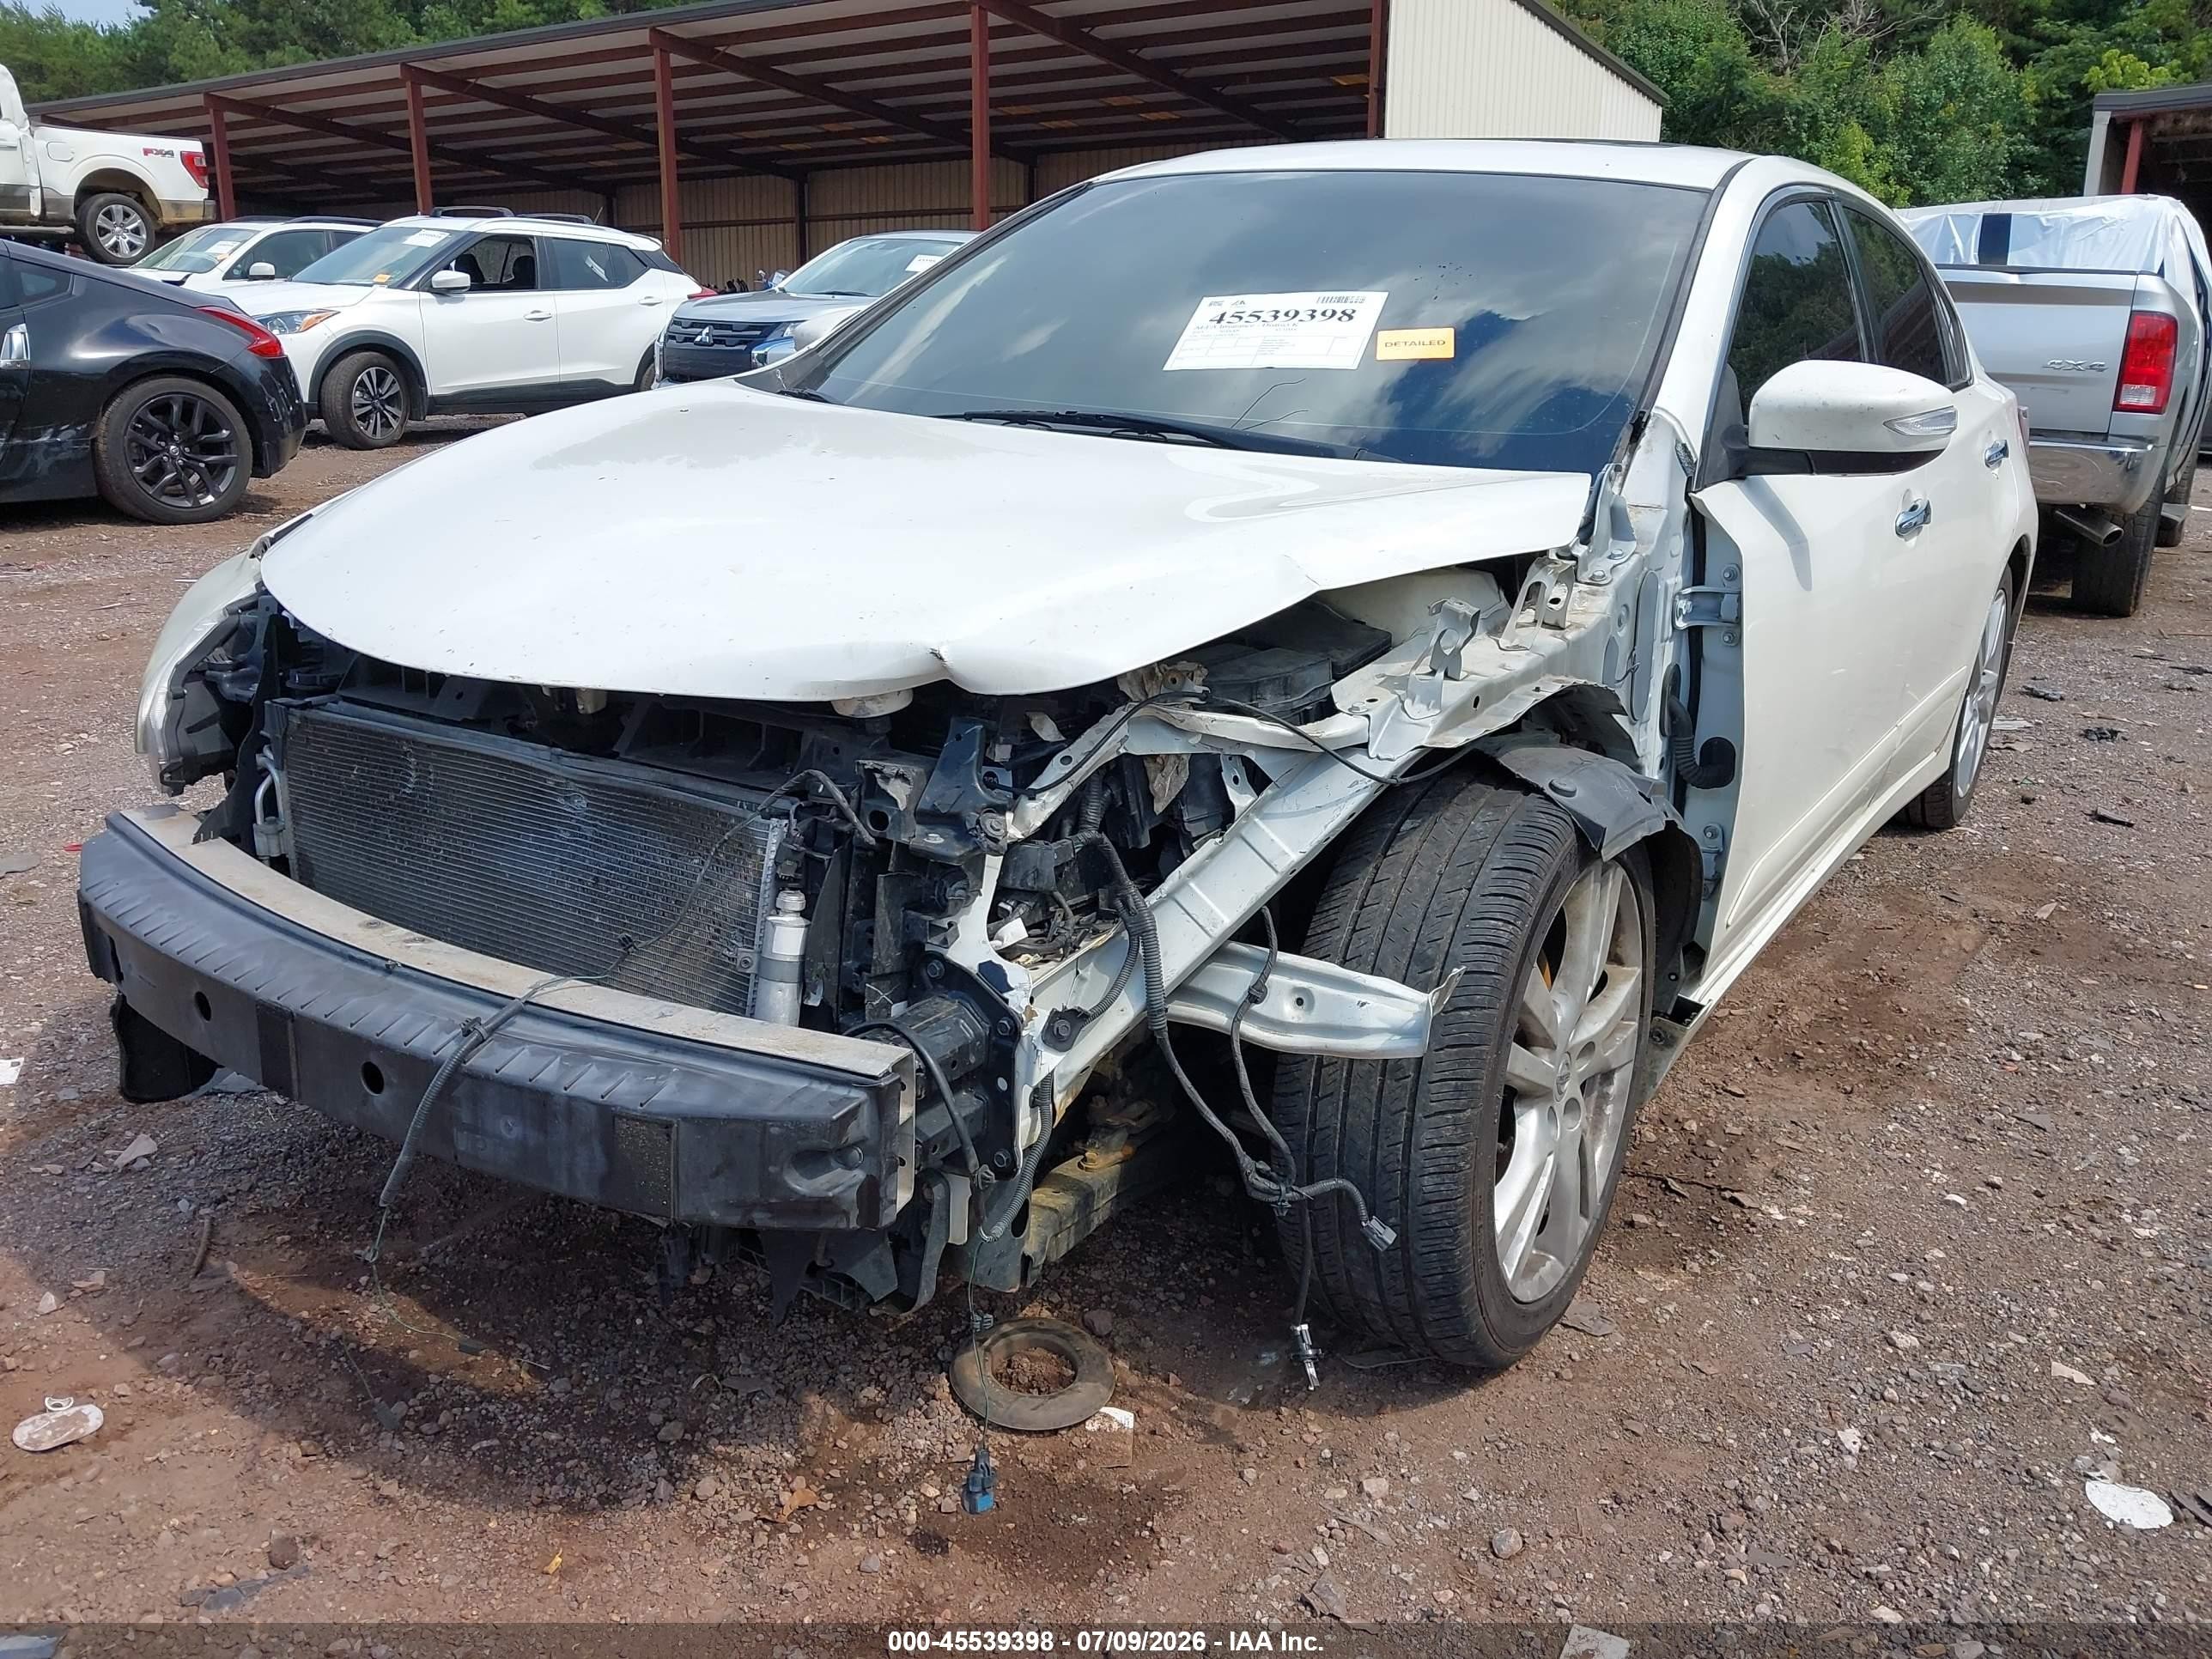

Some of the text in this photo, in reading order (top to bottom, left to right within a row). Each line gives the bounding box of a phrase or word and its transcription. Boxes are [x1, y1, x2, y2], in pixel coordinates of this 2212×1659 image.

[143, 148, 175, 157] FX4
[1209, 308, 1357, 324] 45539398
[1384, 339, 1446, 348] DETAILED
